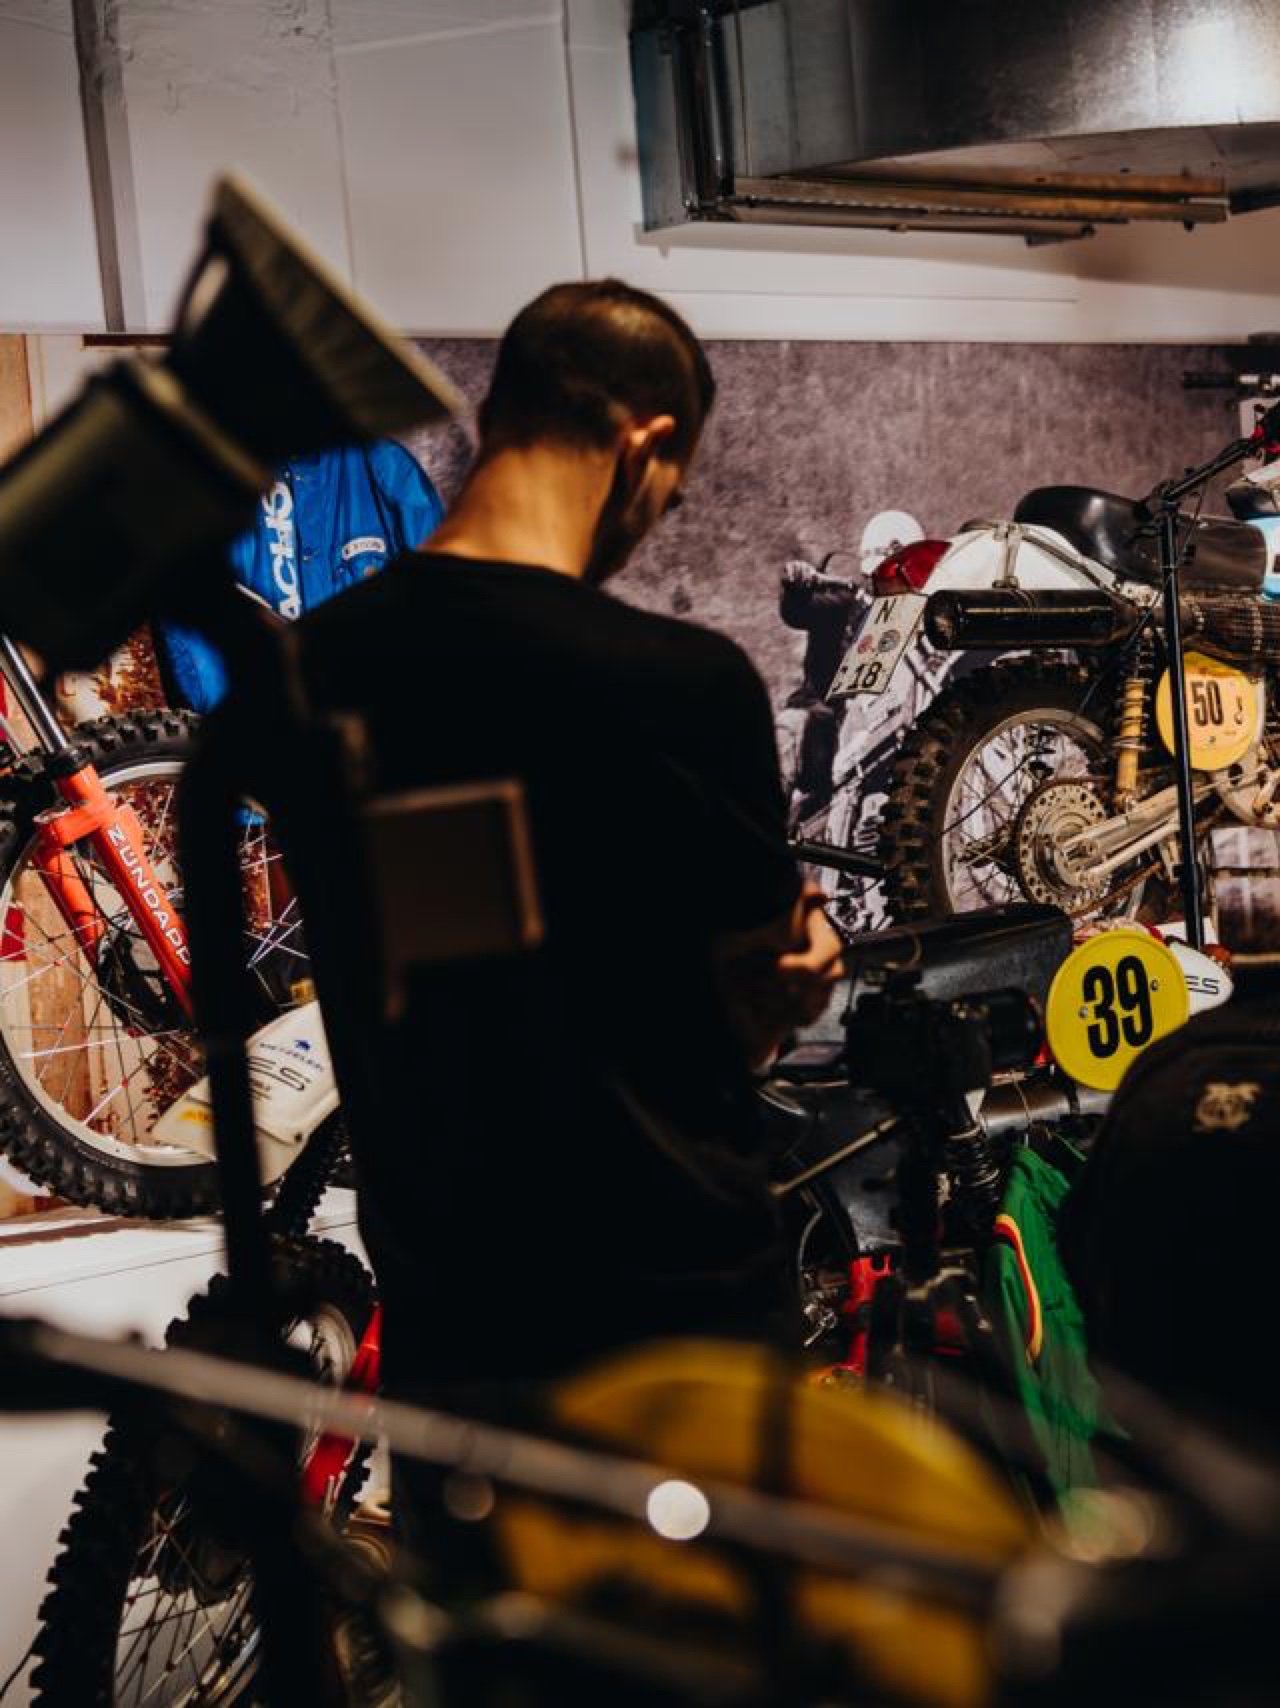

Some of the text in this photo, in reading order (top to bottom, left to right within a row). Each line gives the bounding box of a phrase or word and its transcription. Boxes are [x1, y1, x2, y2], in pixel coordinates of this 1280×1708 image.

[261, 481, 301, 621] ACHS
[874, 598, 897, 625] N
[847, 661, 883, 689] 18
[1191, 680, 1224, 727] 50
[1083, 955, 1153, 1059] 39
